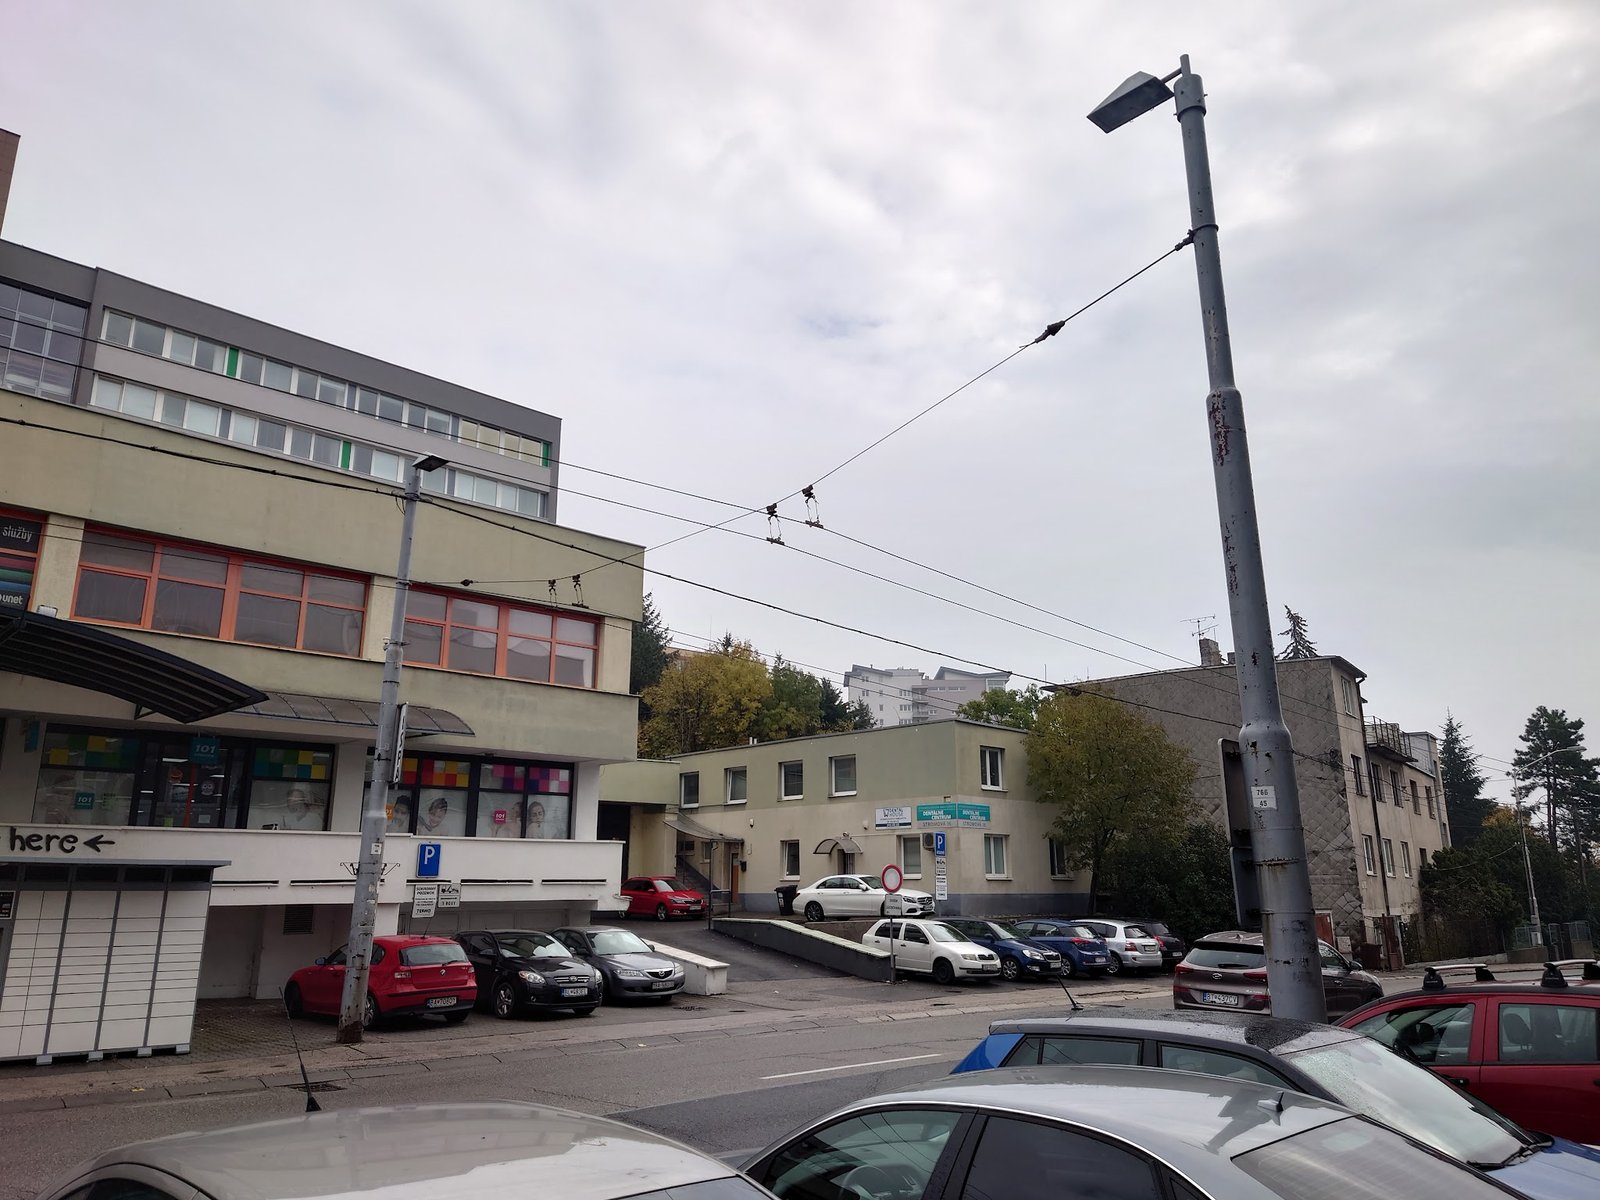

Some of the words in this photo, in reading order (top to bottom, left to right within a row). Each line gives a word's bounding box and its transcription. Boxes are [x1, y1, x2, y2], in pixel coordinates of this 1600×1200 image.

[2, 525, 33, 542] služby
[195, 744, 216, 754] 101
[9, 826, 79, 854] here
[424, 845, 436, 865] P
